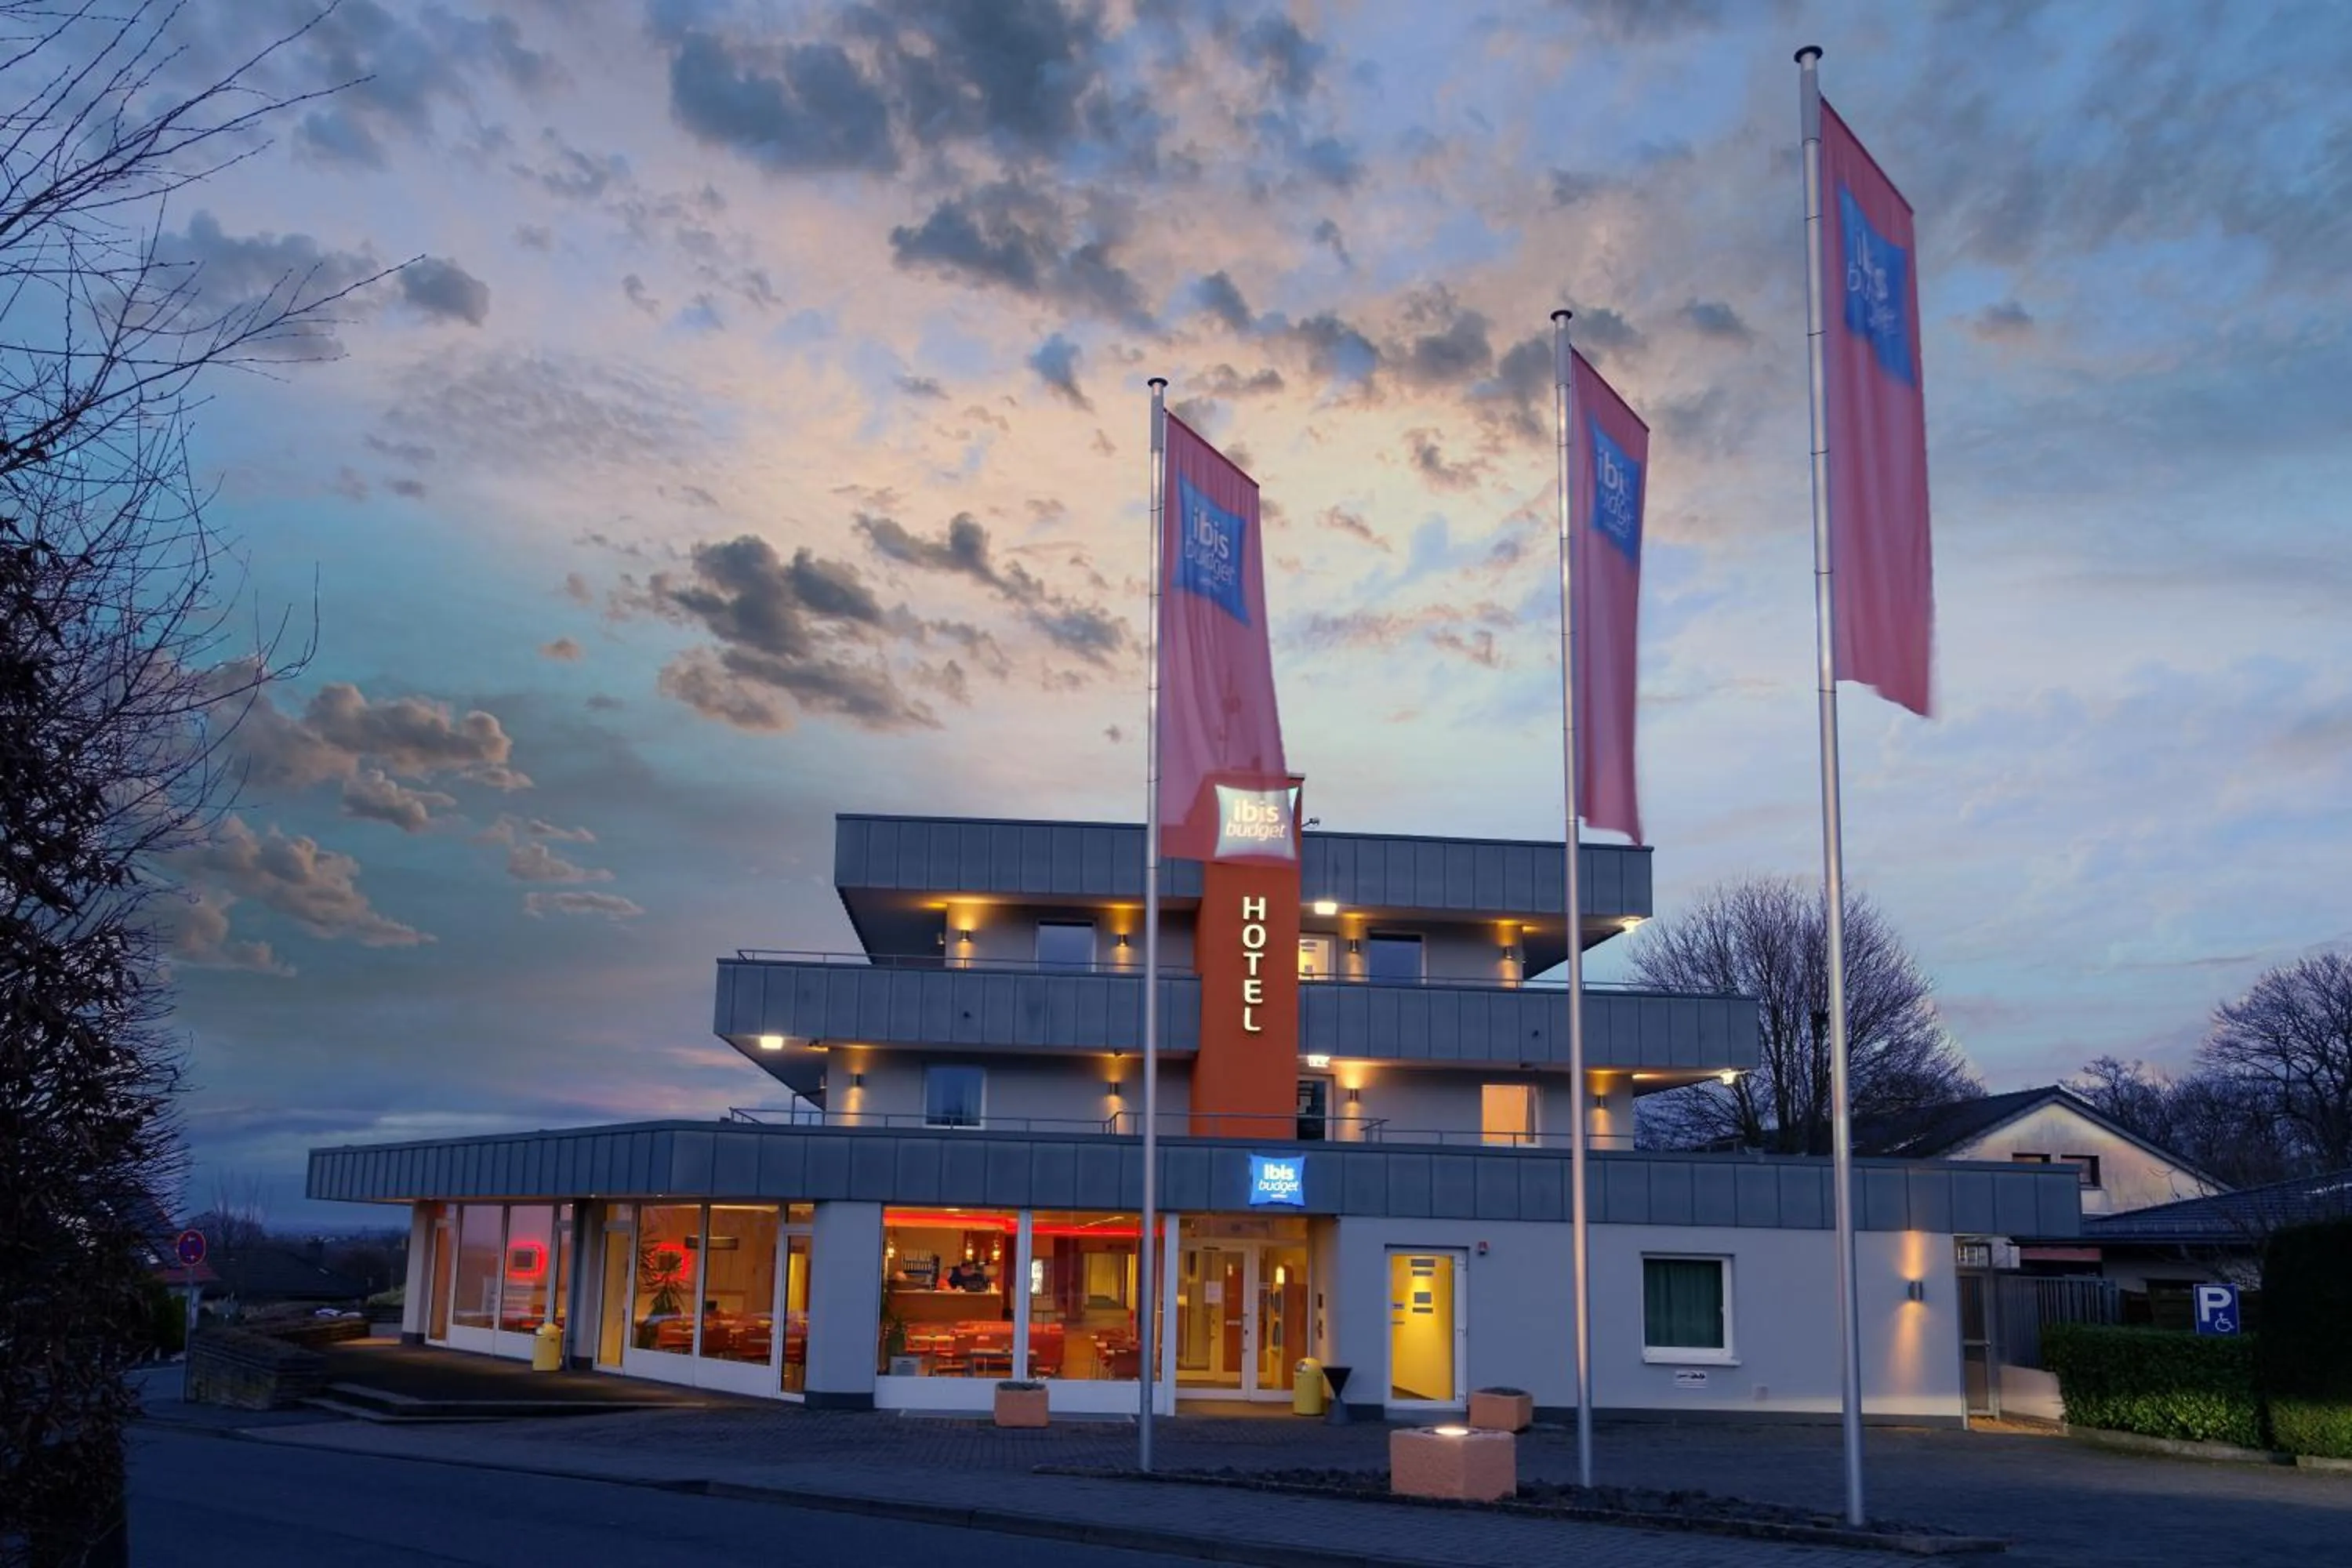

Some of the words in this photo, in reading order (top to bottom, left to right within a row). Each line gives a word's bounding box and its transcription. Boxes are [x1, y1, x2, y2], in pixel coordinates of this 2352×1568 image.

[1192, 506, 1229, 559] ibis
[1233, 798, 1279, 822] ibis
[1226, 815, 1286, 841] budget
[1242, 896, 1267, 1032] HOTEL
[1264, 1163, 1294, 1180] ibis
[1258, 1179, 1298, 1194] budget
[2199, 1287, 2232, 1323] P
